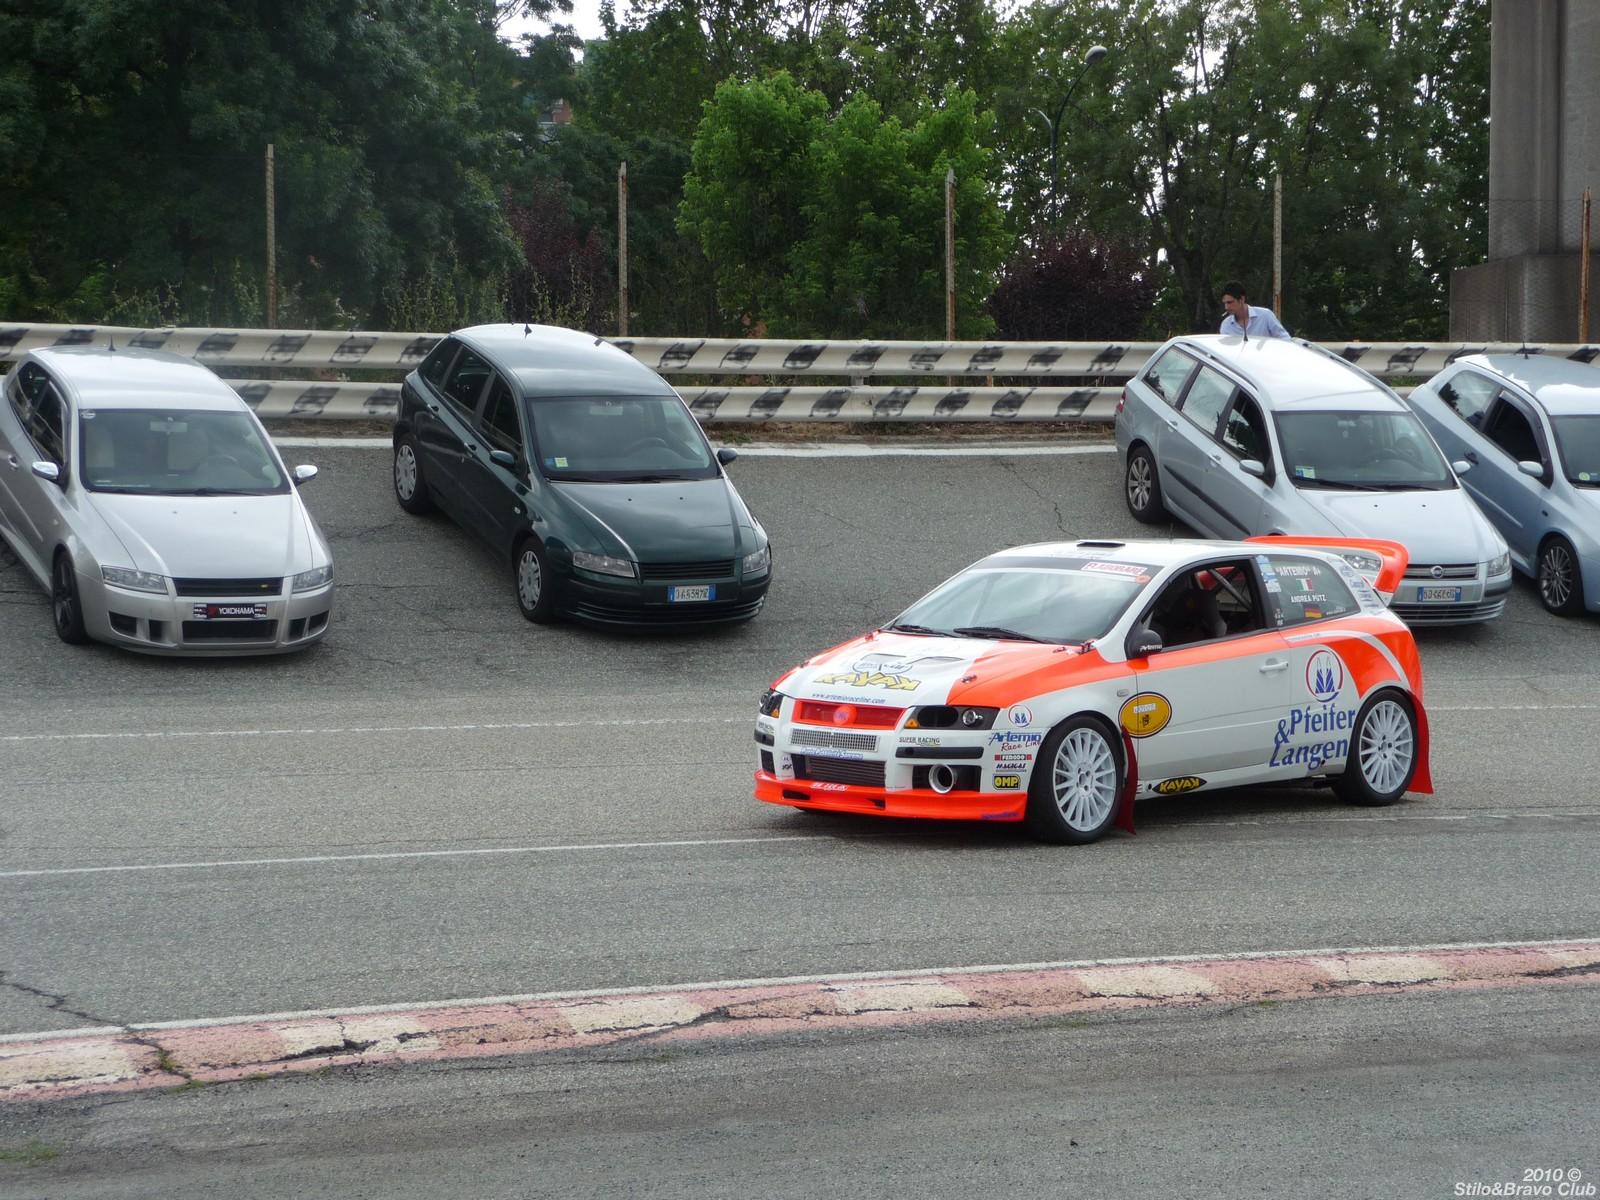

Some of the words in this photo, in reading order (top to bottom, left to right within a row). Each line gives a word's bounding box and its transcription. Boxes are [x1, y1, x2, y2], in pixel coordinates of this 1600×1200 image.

[219, 607, 254, 615] YOKOHAMA
[1290, 703, 1356, 735] Pfeifer
[988, 731, 1042, 745] Artemio
[1274, 719, 1290, 744] &
[1001, 742, 1022, 752] Race
[1269, 739, 1348, 770] Langen
[1159, 778, 1200, 793] KAYAK
